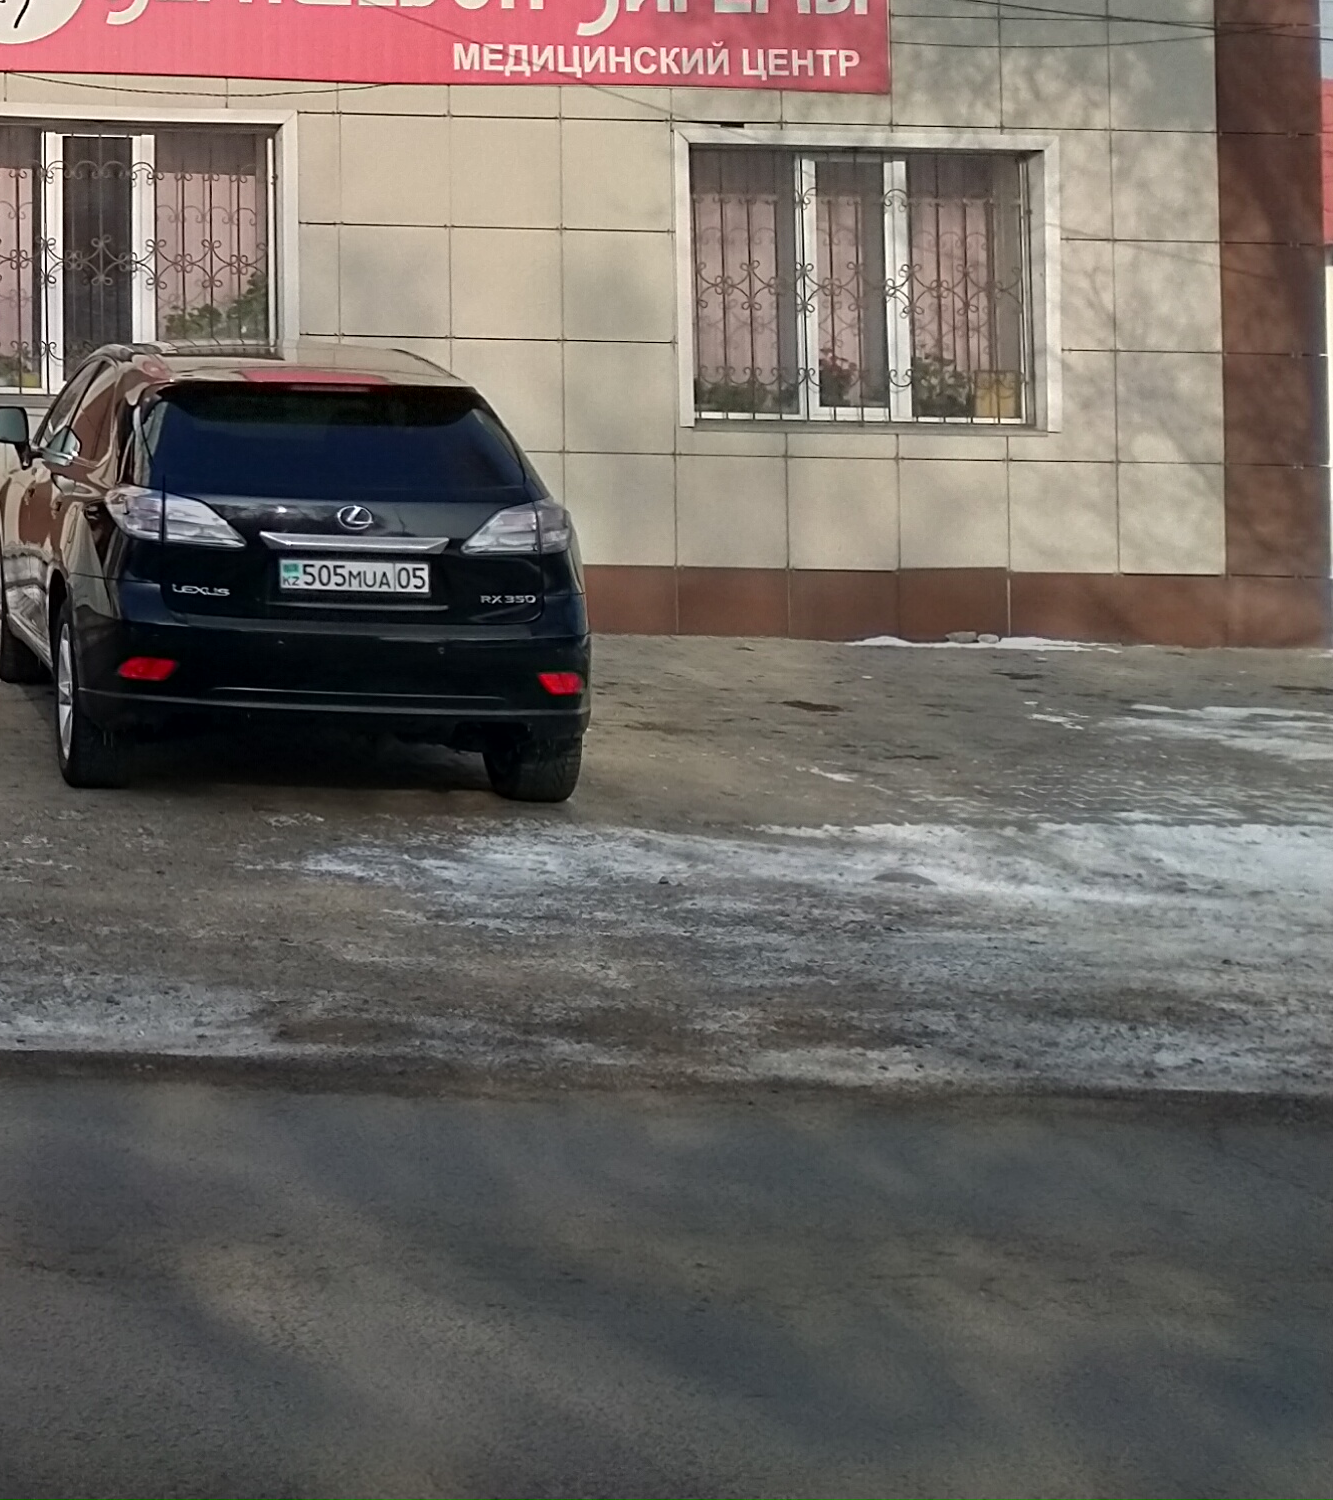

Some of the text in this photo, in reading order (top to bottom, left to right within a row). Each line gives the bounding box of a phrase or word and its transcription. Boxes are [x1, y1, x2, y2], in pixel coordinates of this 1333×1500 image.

[452, 41, 861, 80] МЕДИЦИНСКИЙ ЦЕНТР
[283, 576, 300, 586] KZ
[397, 567, 426, 589] 05
[171, 583, 231, 596] LEXUS
[480, 595, 536, 604] RX 350
